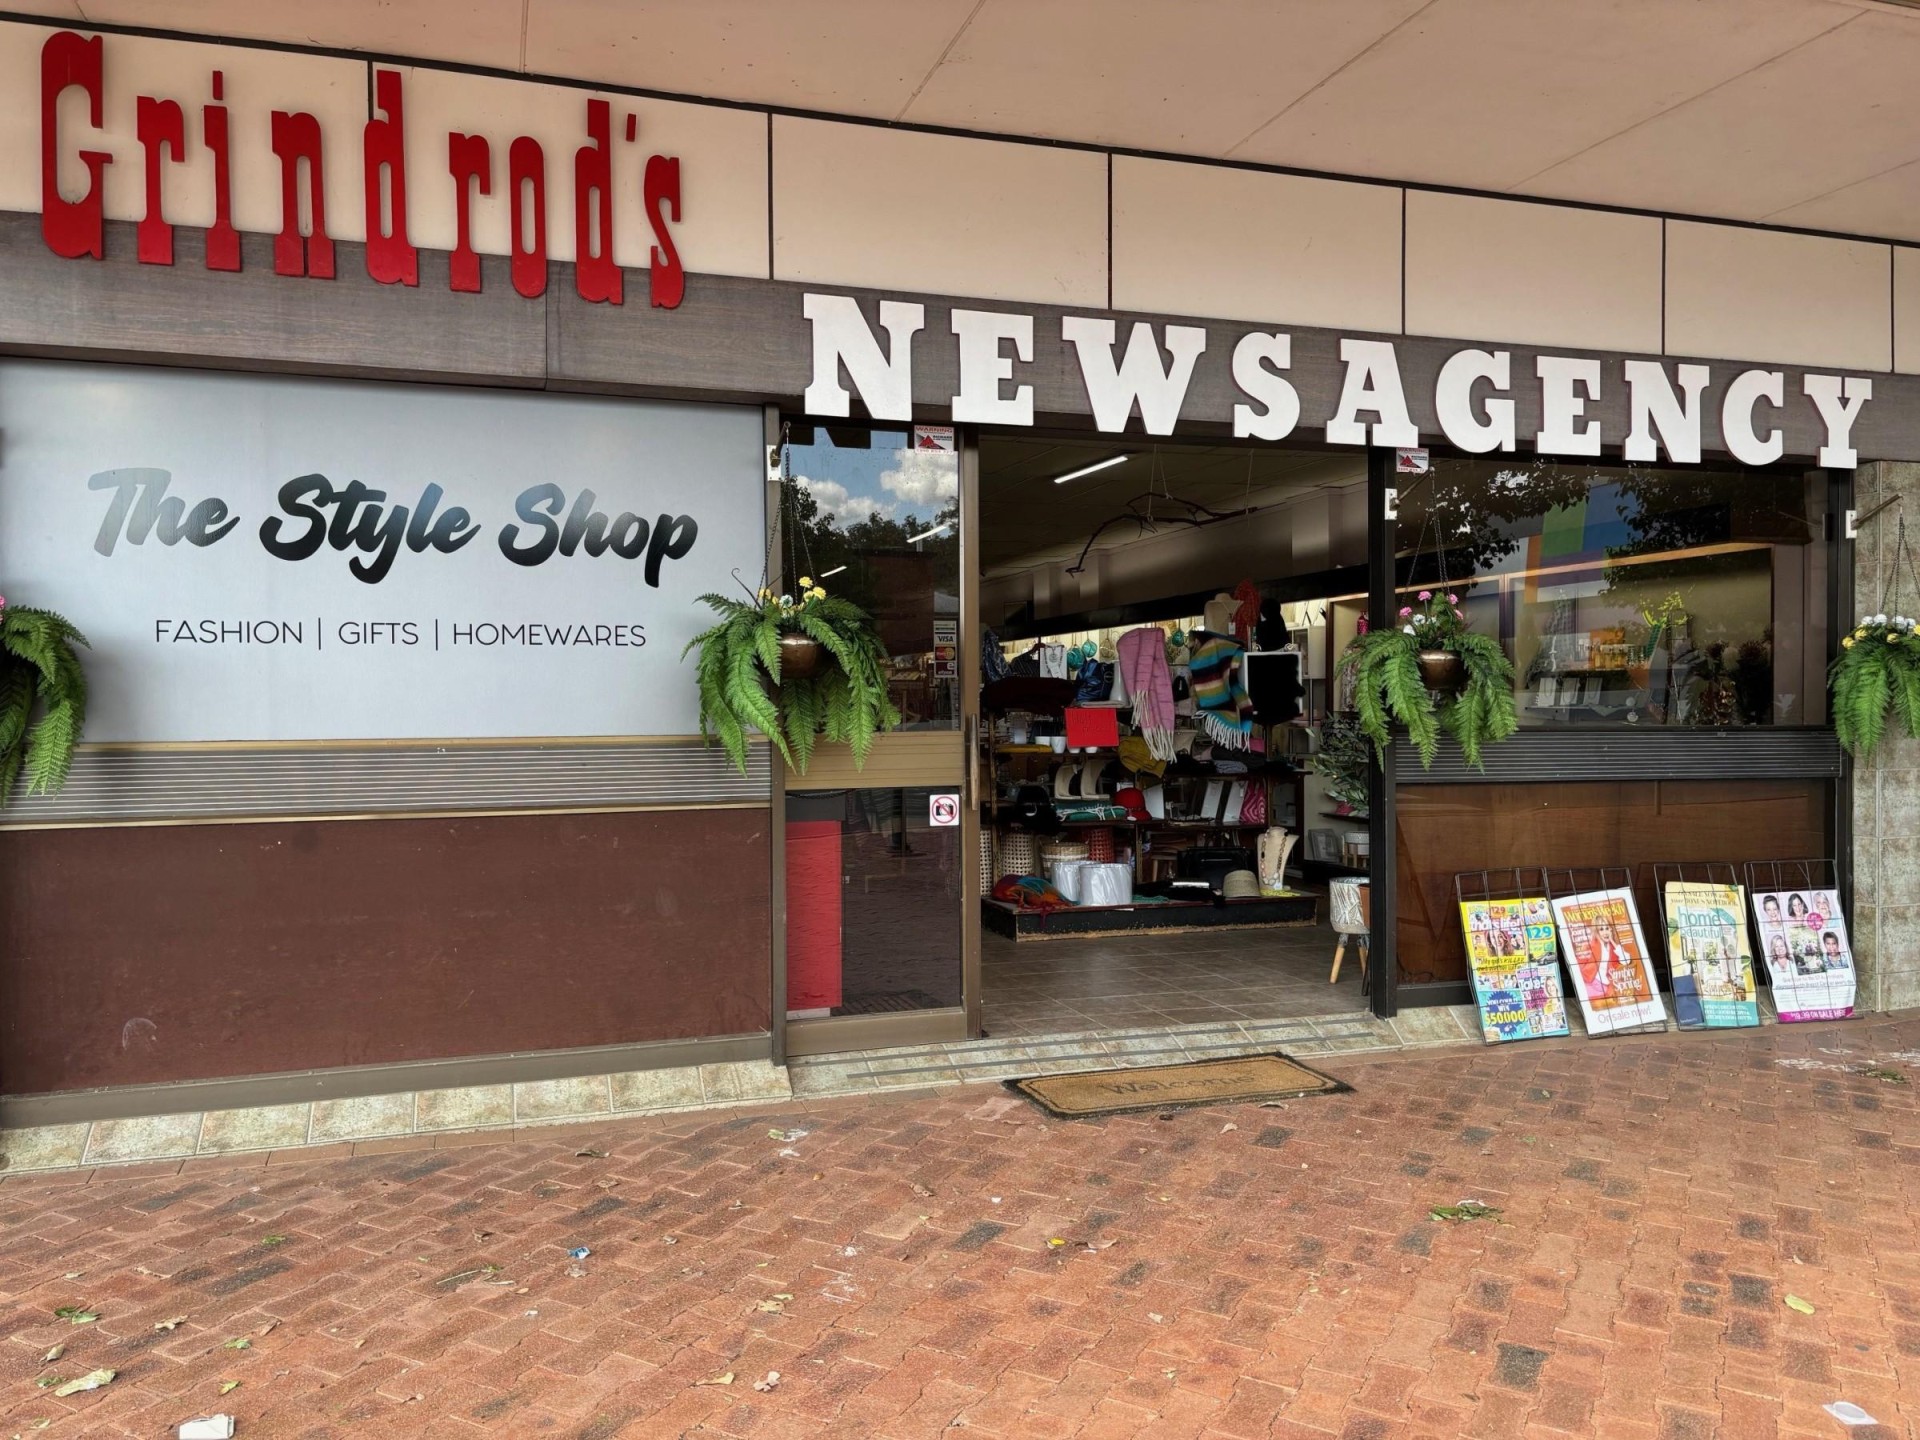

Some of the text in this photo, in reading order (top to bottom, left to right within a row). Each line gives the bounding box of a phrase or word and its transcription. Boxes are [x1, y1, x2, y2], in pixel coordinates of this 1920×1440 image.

[40, 31, 686, 309] Grindrod's
[802, 291, 1873, 470] NEWSAGENCY
[87, 466, 699, 589] The Style Shop
[155, 619, 647, 648] FASHION GIFTS HOMEWARES
[1678, 906, 1721, 926] home
[1526, 926, 1552, 939] 129
[1613, 1010, 1630, 1021] sale
[1098, 1072, 1255, 1096] Welcome
